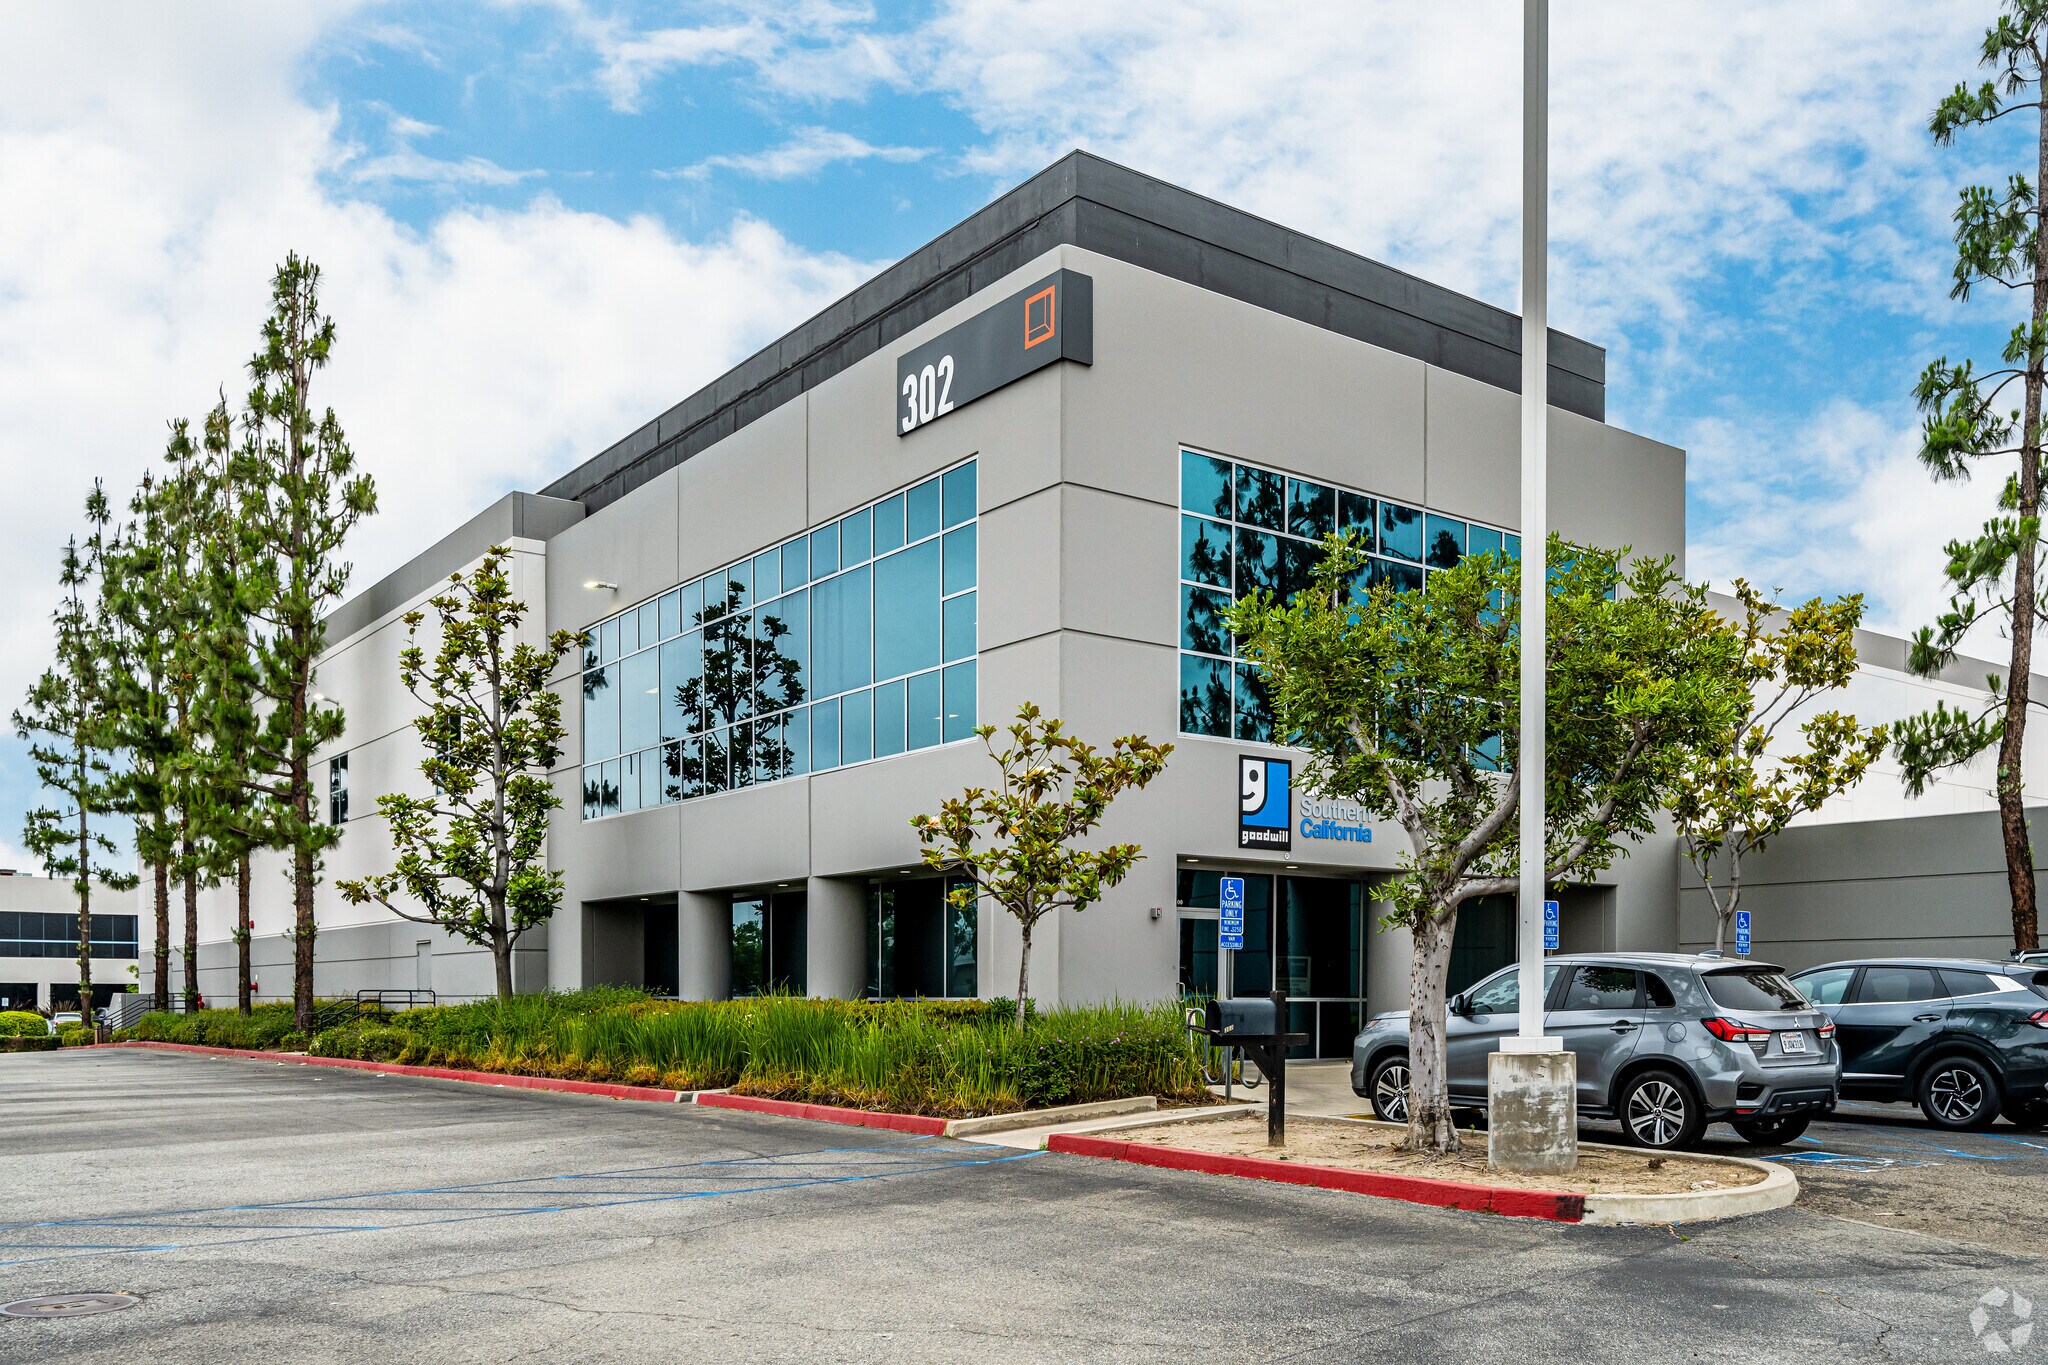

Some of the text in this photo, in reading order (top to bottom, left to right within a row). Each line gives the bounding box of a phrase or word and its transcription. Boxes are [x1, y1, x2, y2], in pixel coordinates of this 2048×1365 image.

[902, 354, 955, 433] 302
[1301, 798, 1372, 823] Southern
[1242, 829, 1289, 845] goodwill
[1300, 817, 1372, 843] California
[1221, 900, 1242, 909] PARKING
[1225, 909, 1238, 918] ONLY
